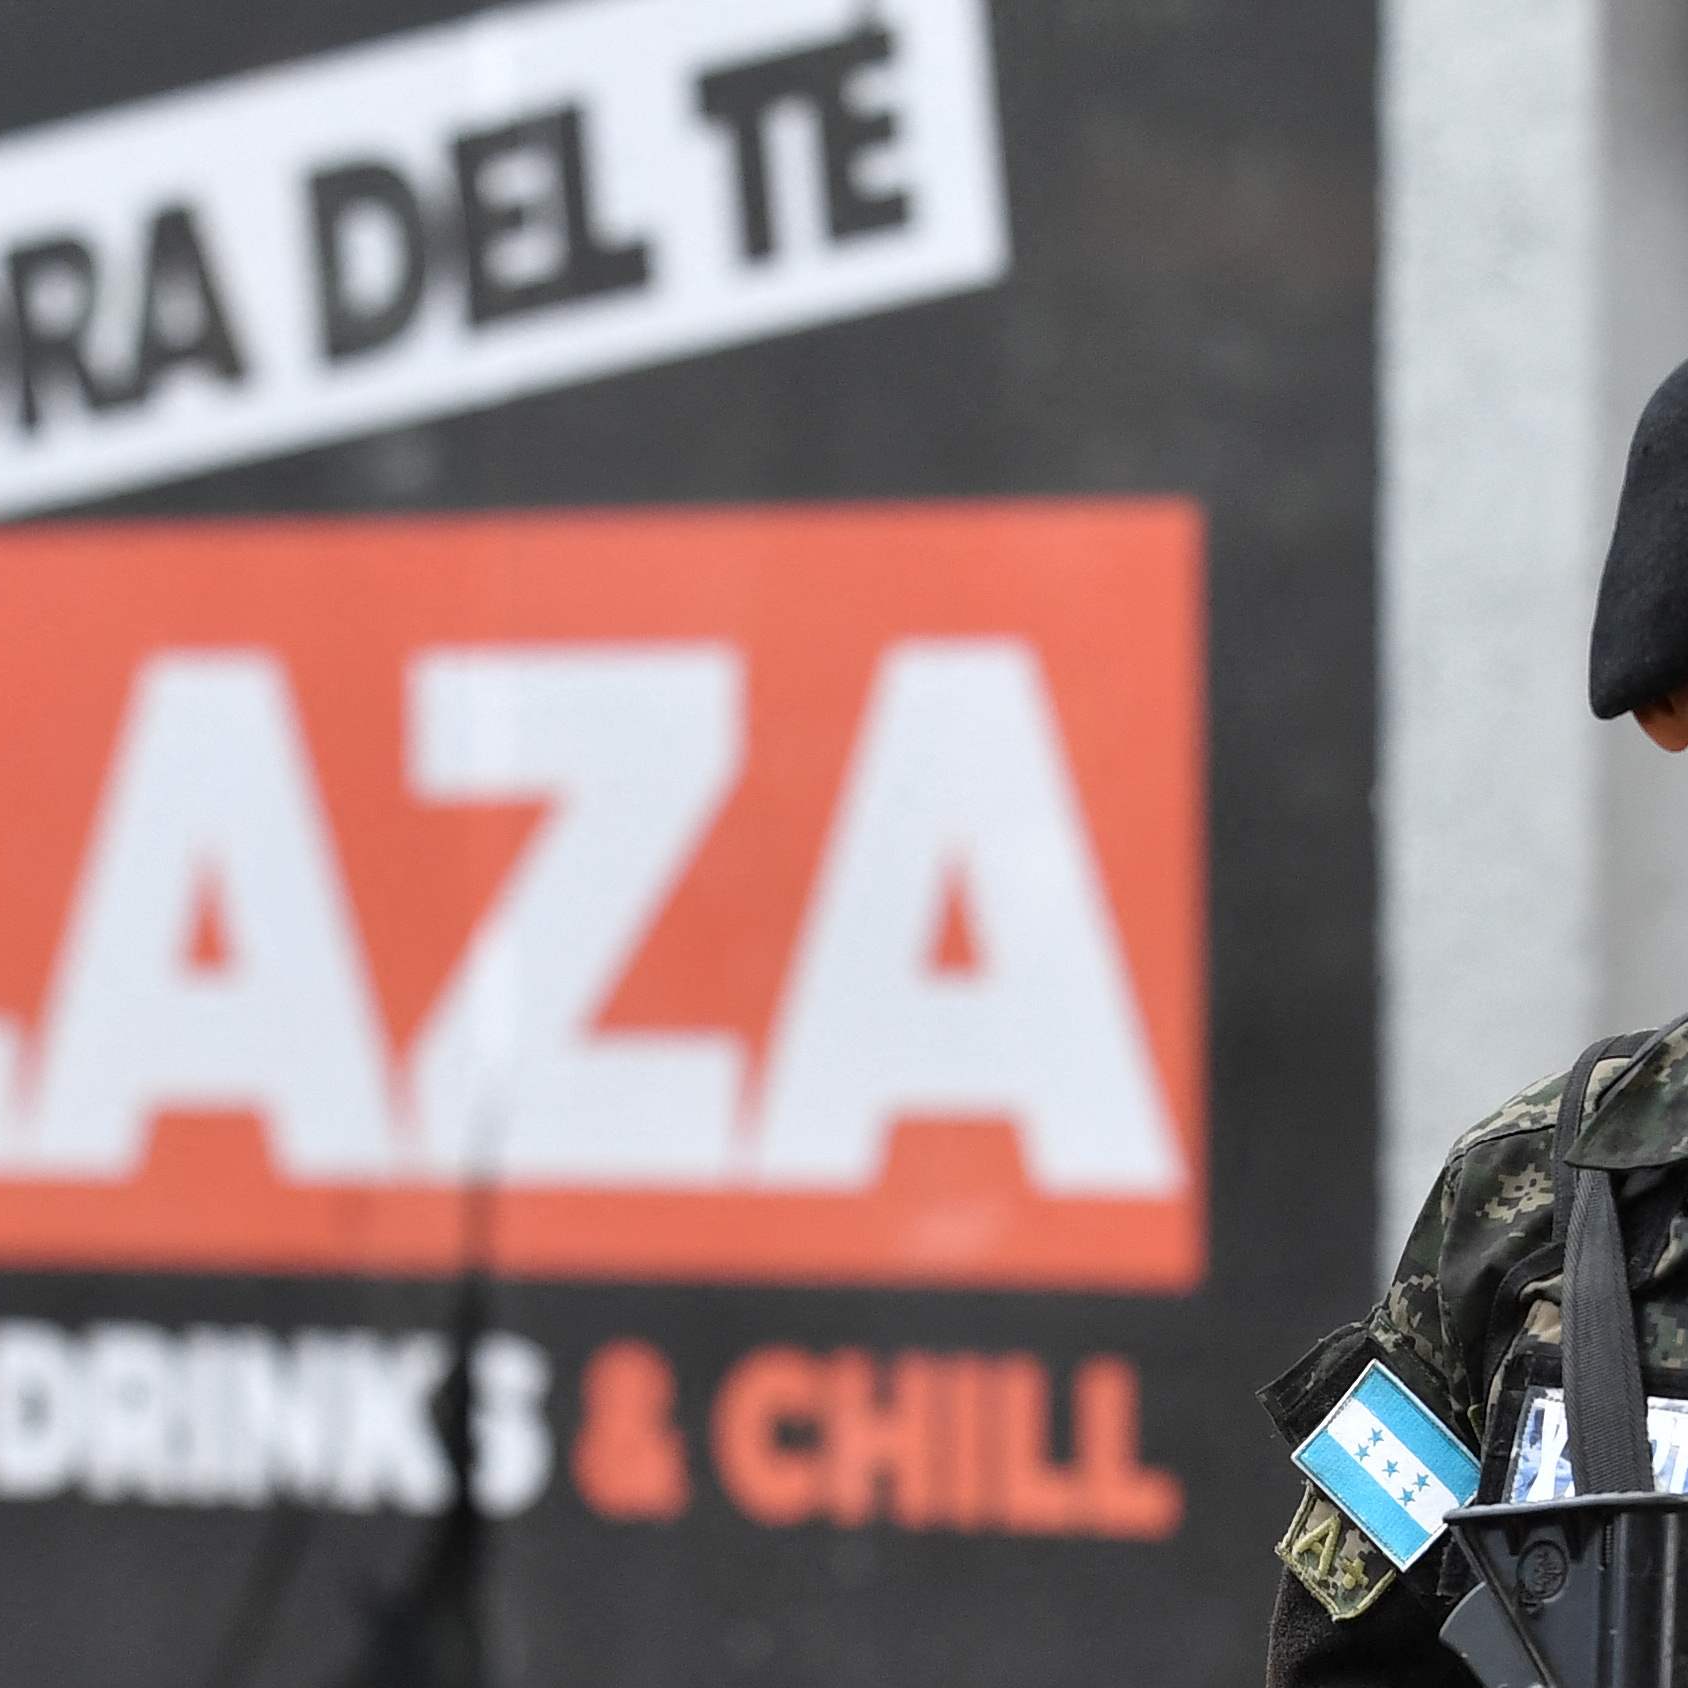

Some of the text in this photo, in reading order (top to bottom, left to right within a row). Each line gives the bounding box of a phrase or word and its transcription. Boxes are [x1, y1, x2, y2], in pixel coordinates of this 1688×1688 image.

[310, 100, 652, 368] DEL
[574, 1342, 688, 1518] &
[718, 1352, 1182, 1540] CHILL
